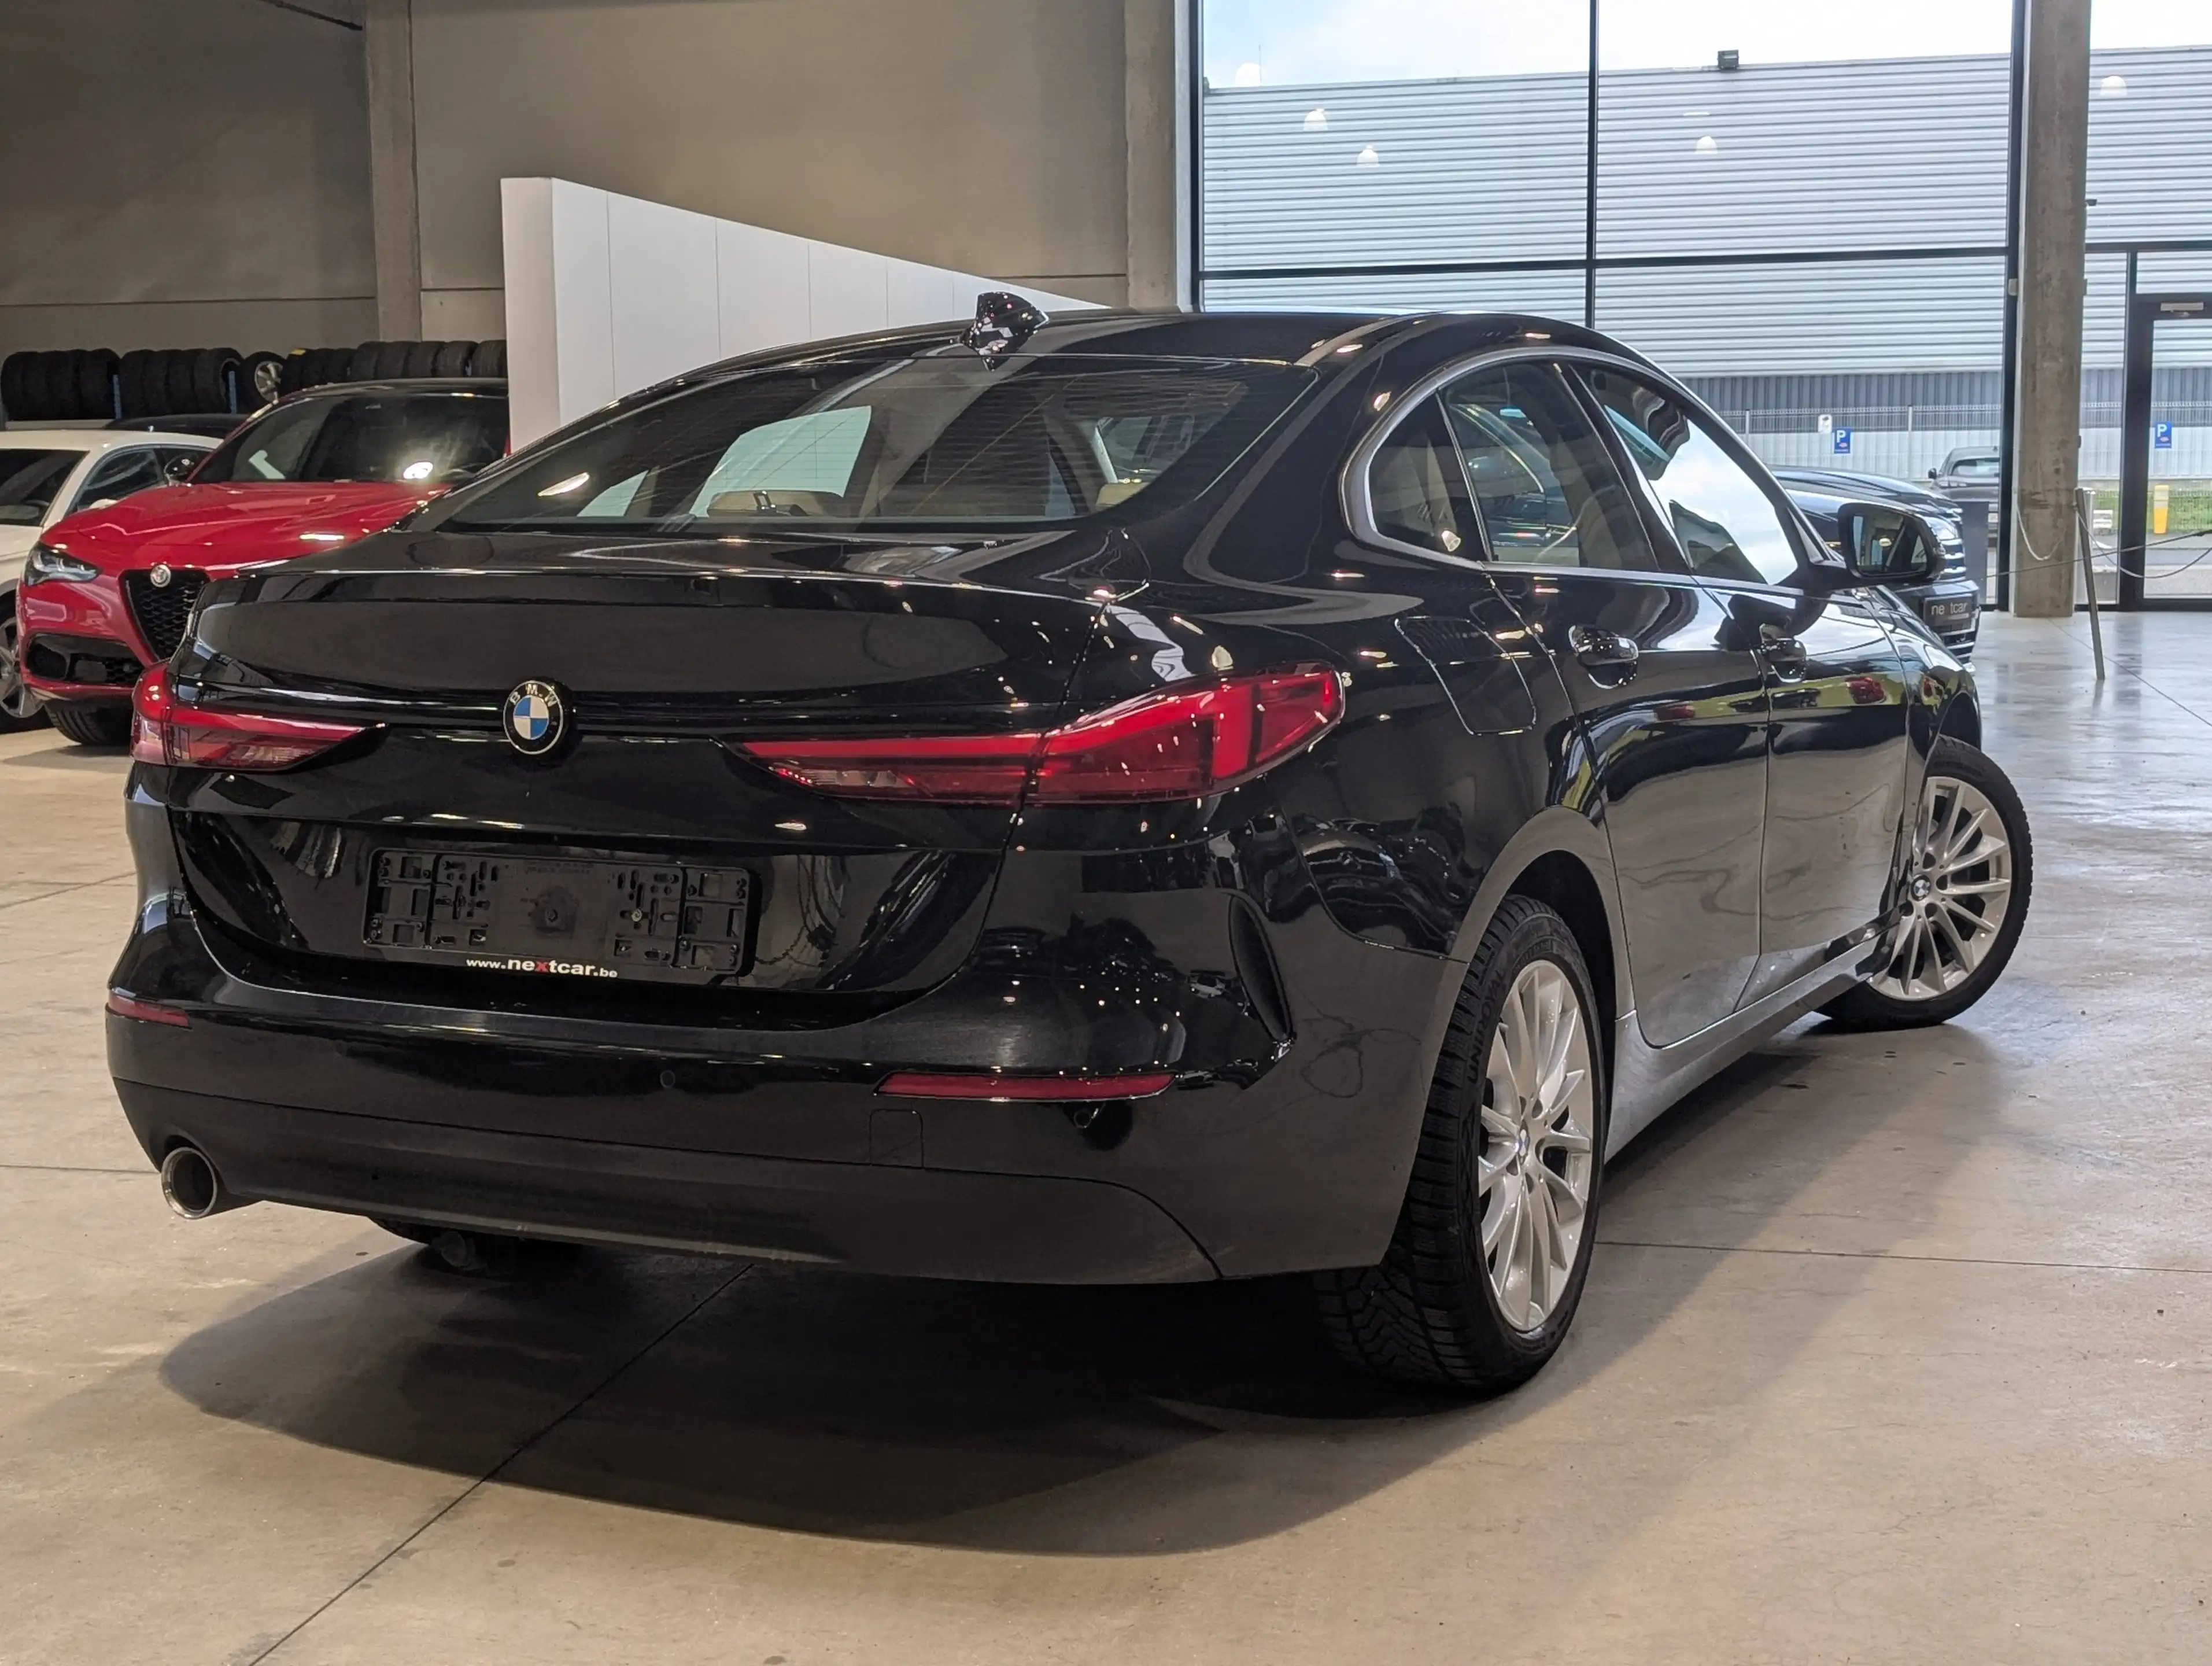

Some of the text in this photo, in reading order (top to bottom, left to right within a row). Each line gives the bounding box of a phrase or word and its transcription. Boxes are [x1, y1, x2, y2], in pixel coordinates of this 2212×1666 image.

[1837, 430, 1846, 443] P
[2157, 423, 2167, 437] P
[1931, 602, 1968, 615] netcar
[509, 683, 558, 707] BMW
[466, 959, 618, 978] www.nextcar.be
